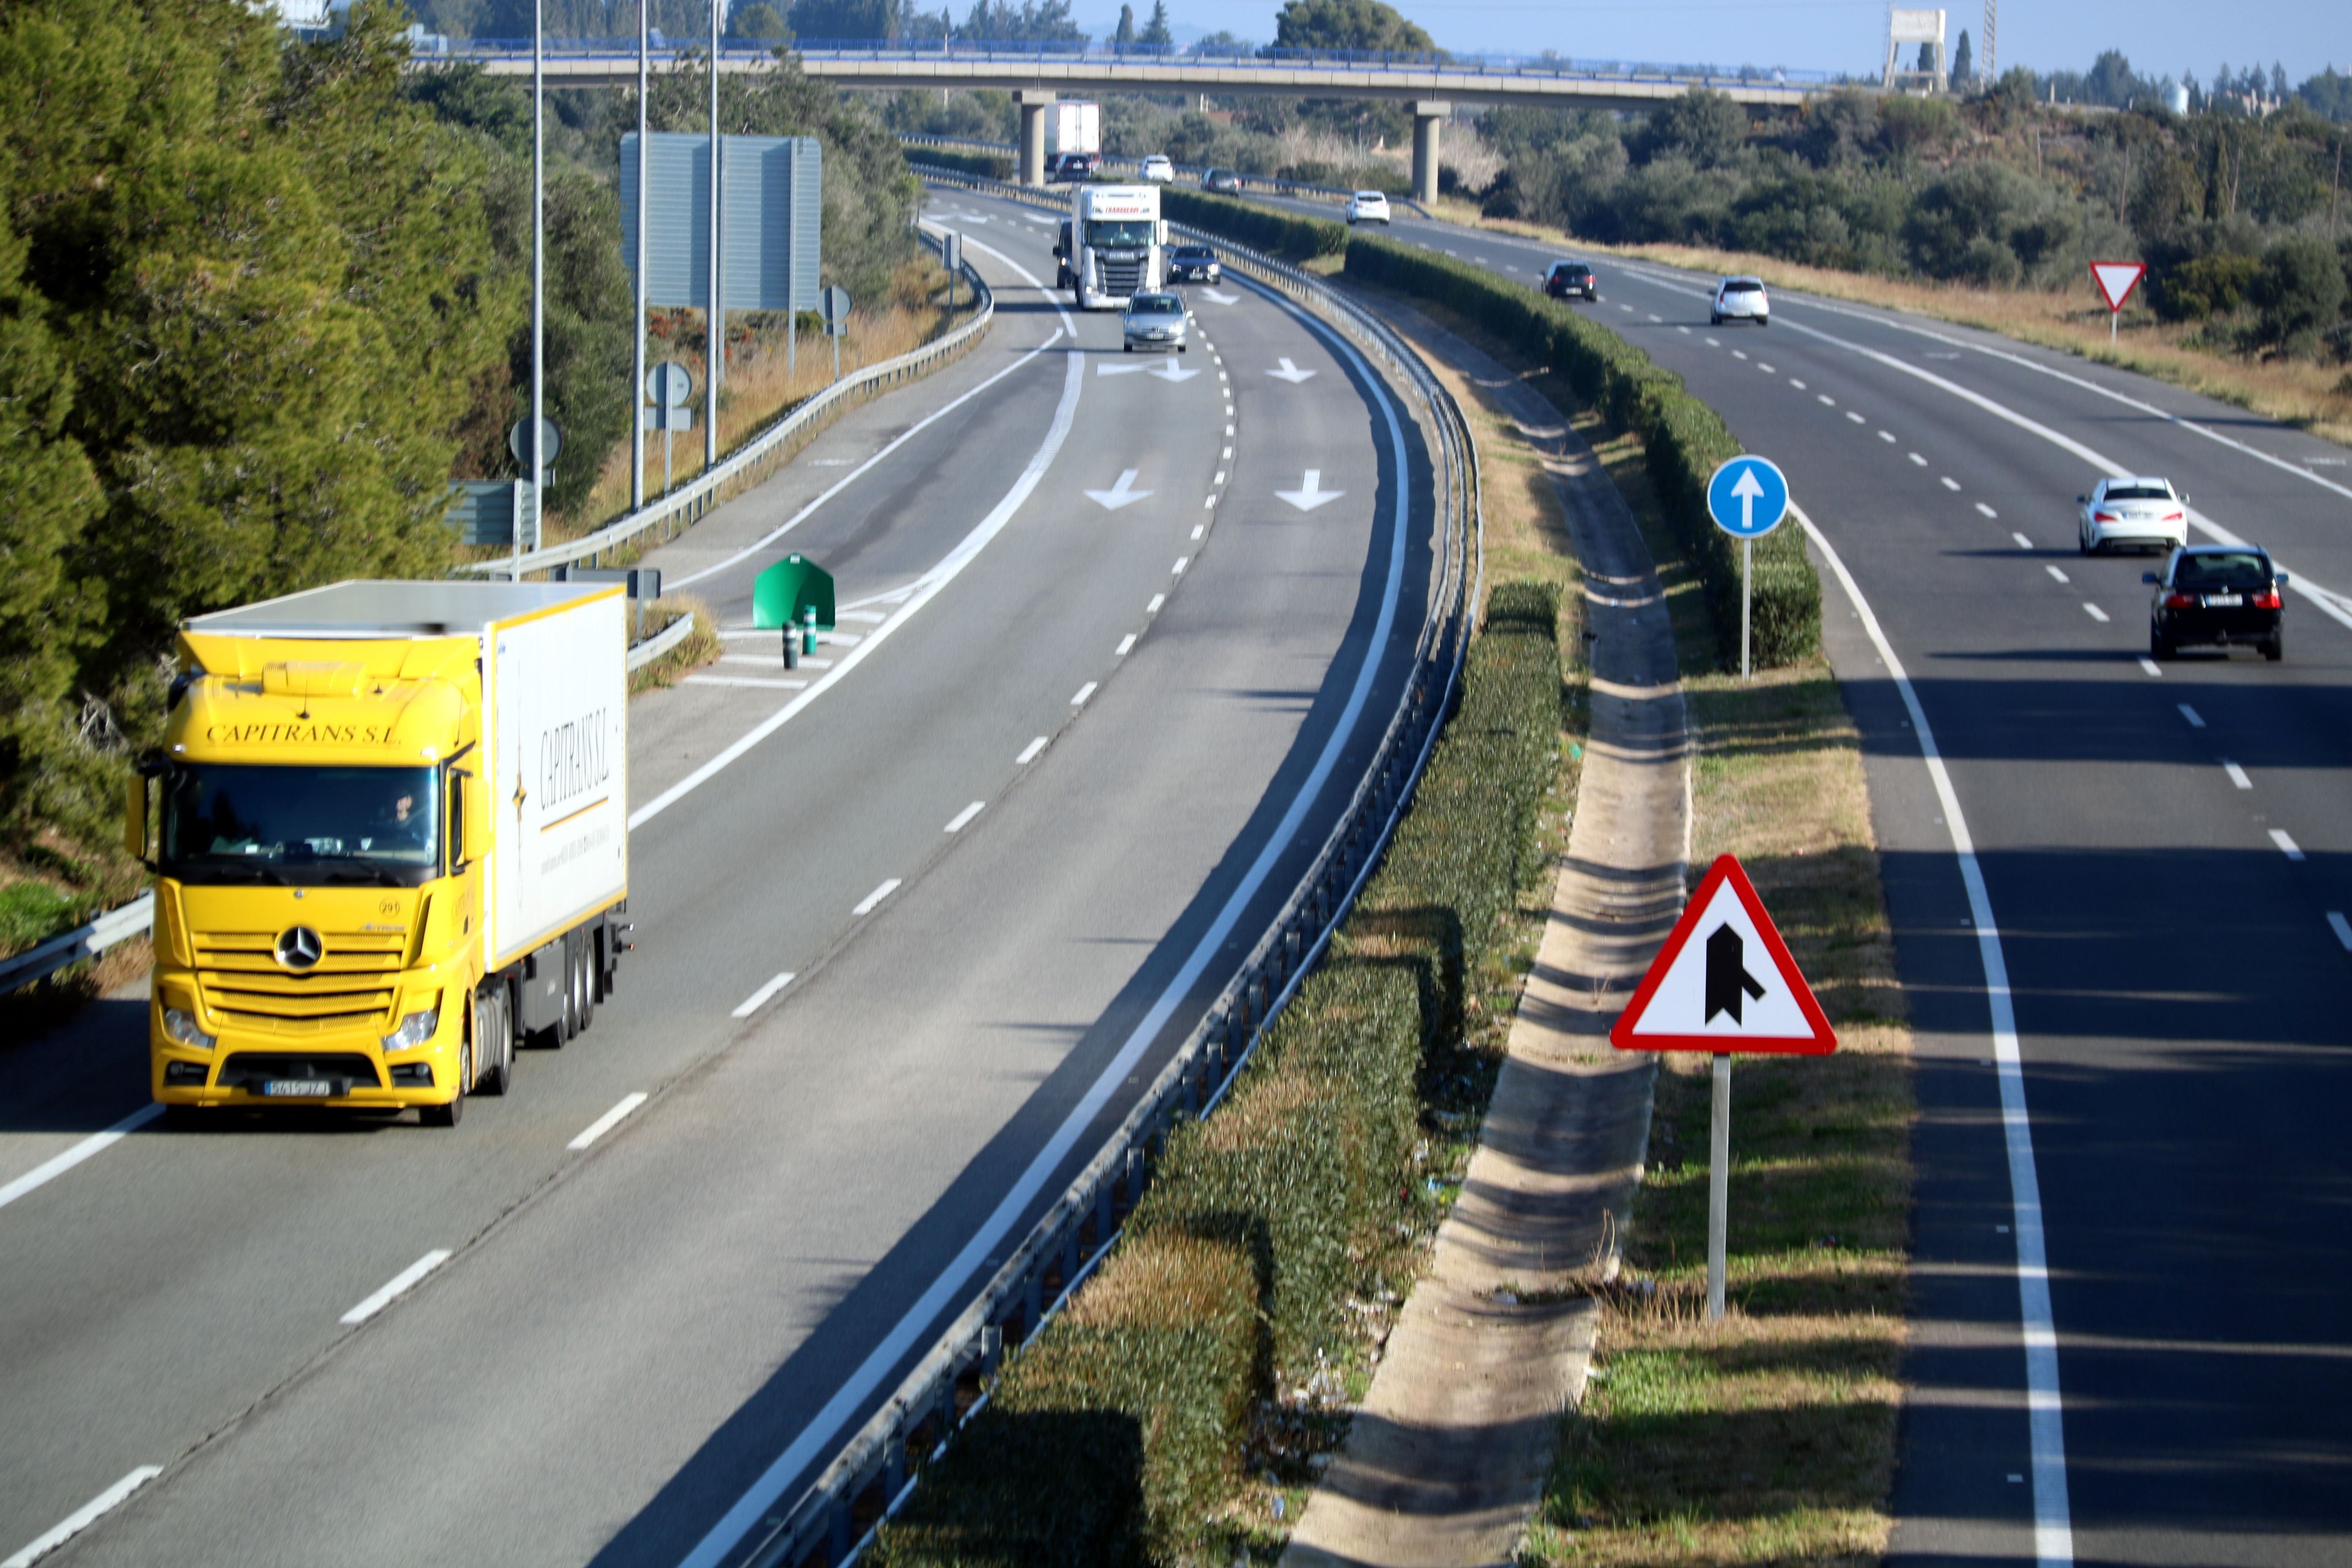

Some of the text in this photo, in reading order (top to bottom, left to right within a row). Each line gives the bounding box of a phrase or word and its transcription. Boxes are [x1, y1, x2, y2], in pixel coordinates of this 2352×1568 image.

[207, 725, 401, 744] CAPITRANS S.L.
[540, 713, 592, 811] CAPITRANS
[382, 901, 398, 914] 291
